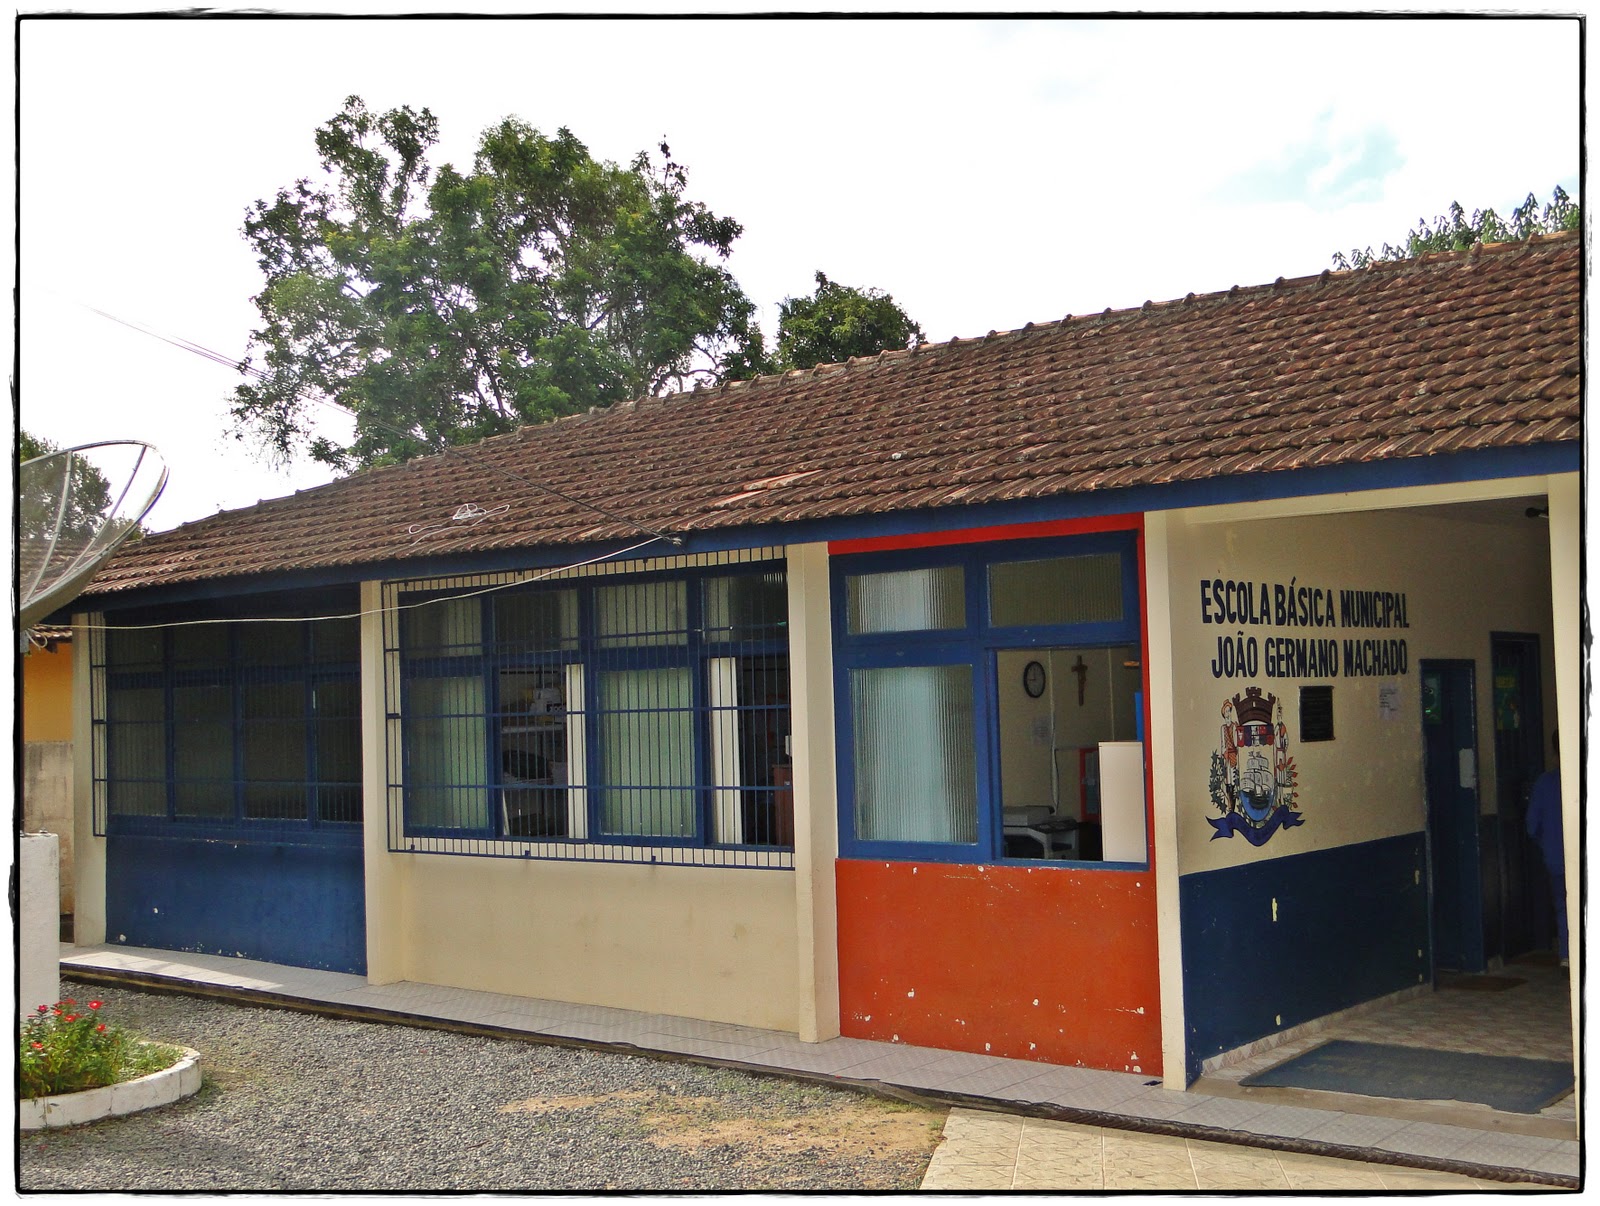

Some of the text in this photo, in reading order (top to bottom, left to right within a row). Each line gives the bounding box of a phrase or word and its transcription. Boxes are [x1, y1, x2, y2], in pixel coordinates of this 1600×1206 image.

[1201, 576, 1409, 628] ESCOLA BÁSICA MUNICIPAL
[1212, 631, 1258, 678] JOÃO
[1265, 637, 1338, 678] GERMANO
